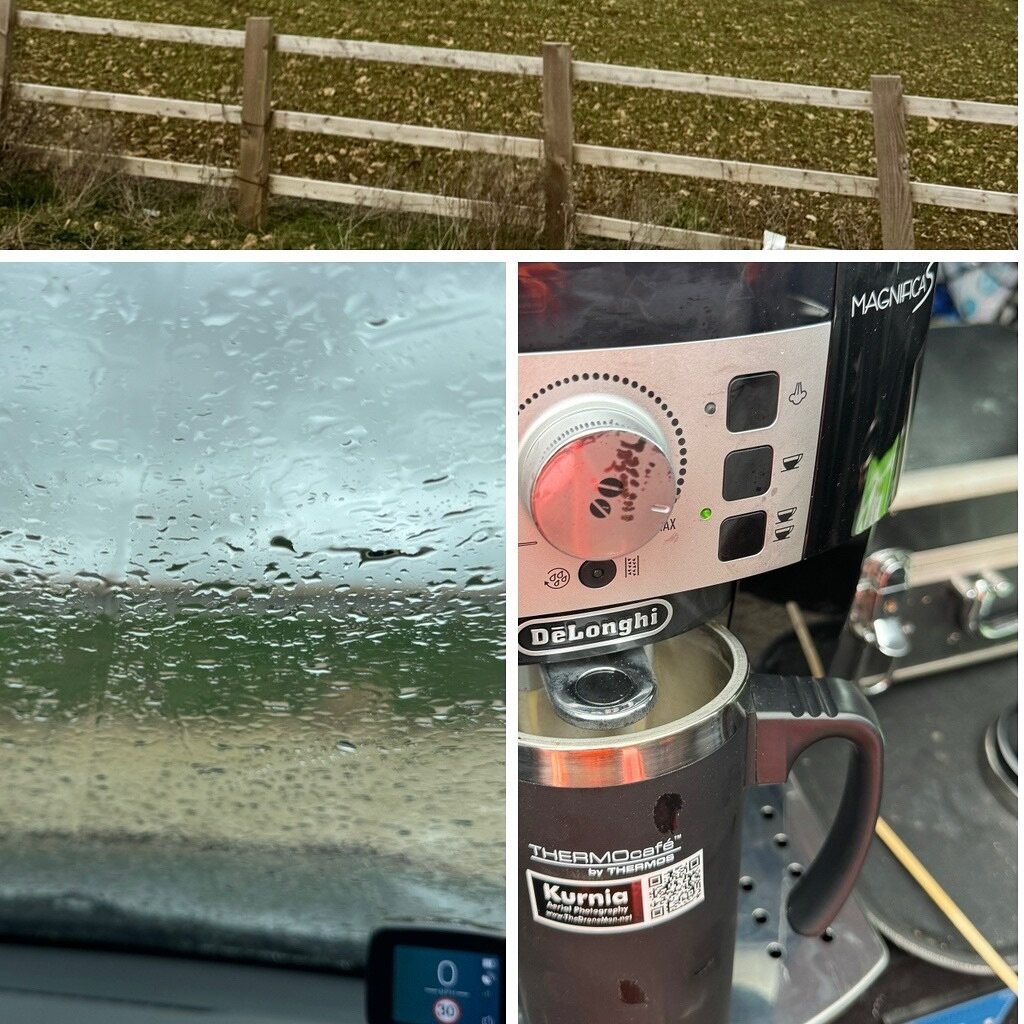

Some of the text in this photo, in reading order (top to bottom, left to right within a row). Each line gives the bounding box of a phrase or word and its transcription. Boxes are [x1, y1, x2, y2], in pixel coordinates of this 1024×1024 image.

[851, 274, 927, 318] MAGNIFICA
[660, 517, 677, 532] AX
[588, 853, 676, 878] by THERMOS
[542, 882, 629, 907] Kurnia
[546, 900, 629, 917] Aerial Photography
[437, 959, 459, 989] 0
